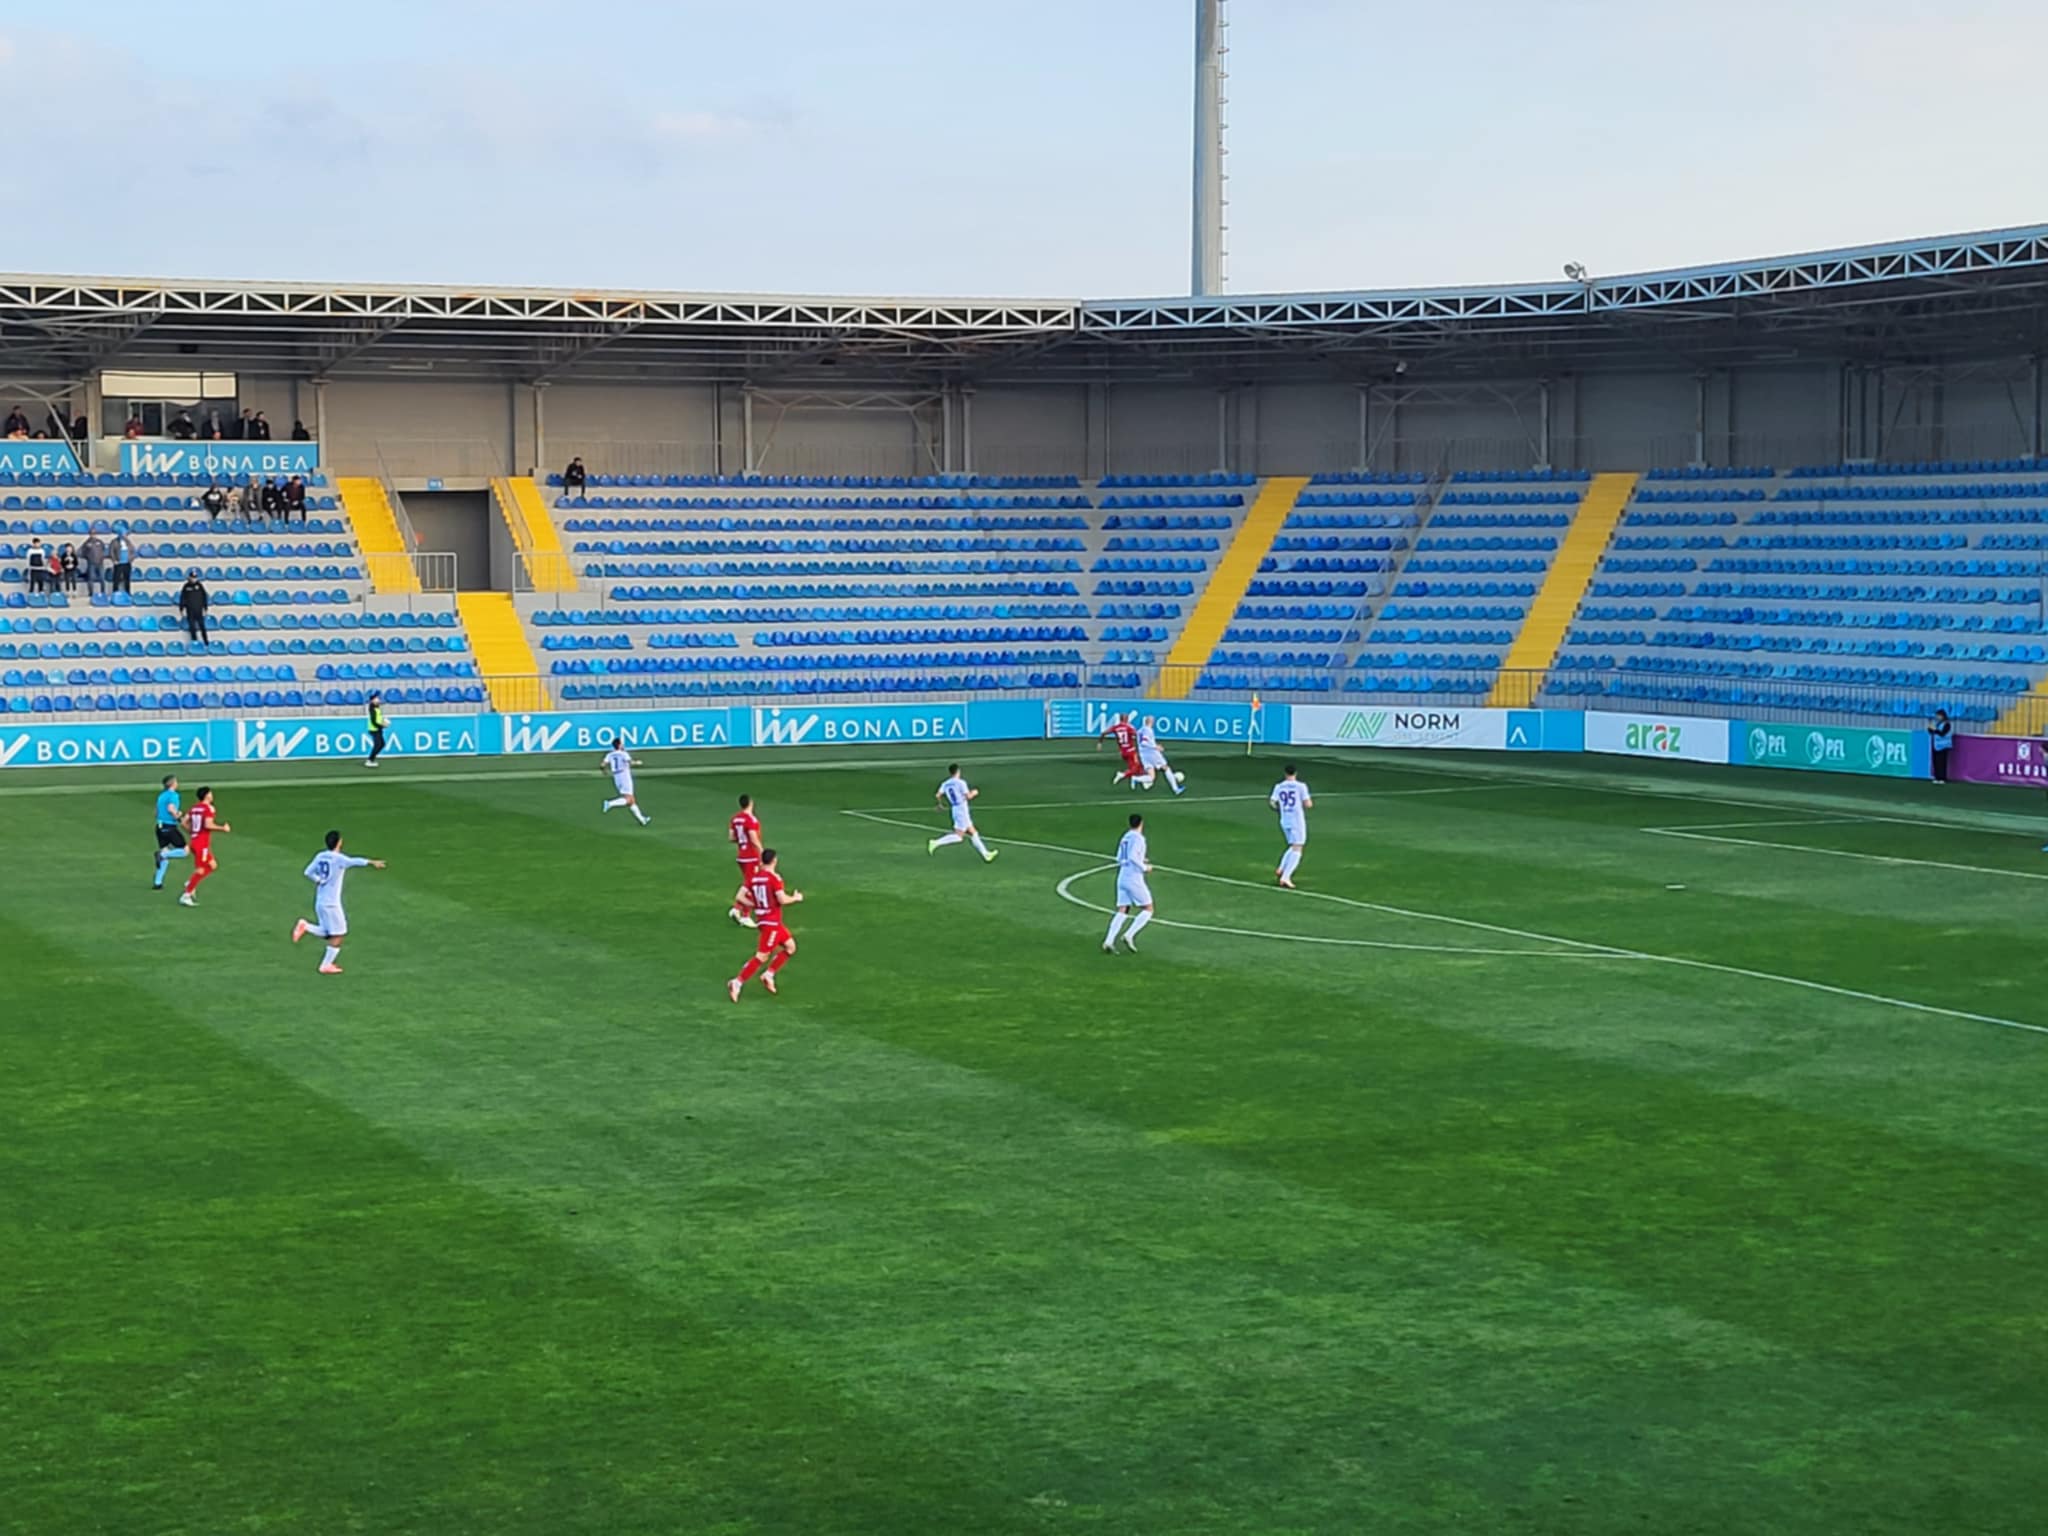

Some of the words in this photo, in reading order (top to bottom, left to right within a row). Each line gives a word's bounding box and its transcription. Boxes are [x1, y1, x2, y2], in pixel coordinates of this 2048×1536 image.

[23, 454, 71, 470] DEA
[188, 455, 253, 470] BONA
[263, 455, 308, 470] DEA
[824, 719, 902, 738] BONA
[911, 717, 965, 736] DEA
[1143, 716, 1206, 735] ONA
[1394, 713, 1460, 730] NORM
[414, 730, 475, 750] DEA
[577, 726, 659, 746] BONA
[670, 723, 727, 743] DEA
[1626, 722, 1681, 753] araz
[37, 739, 130, 761] BONA
[143, 737, 207, 758] DEA
[1279, 791, 1296, 807] 95
